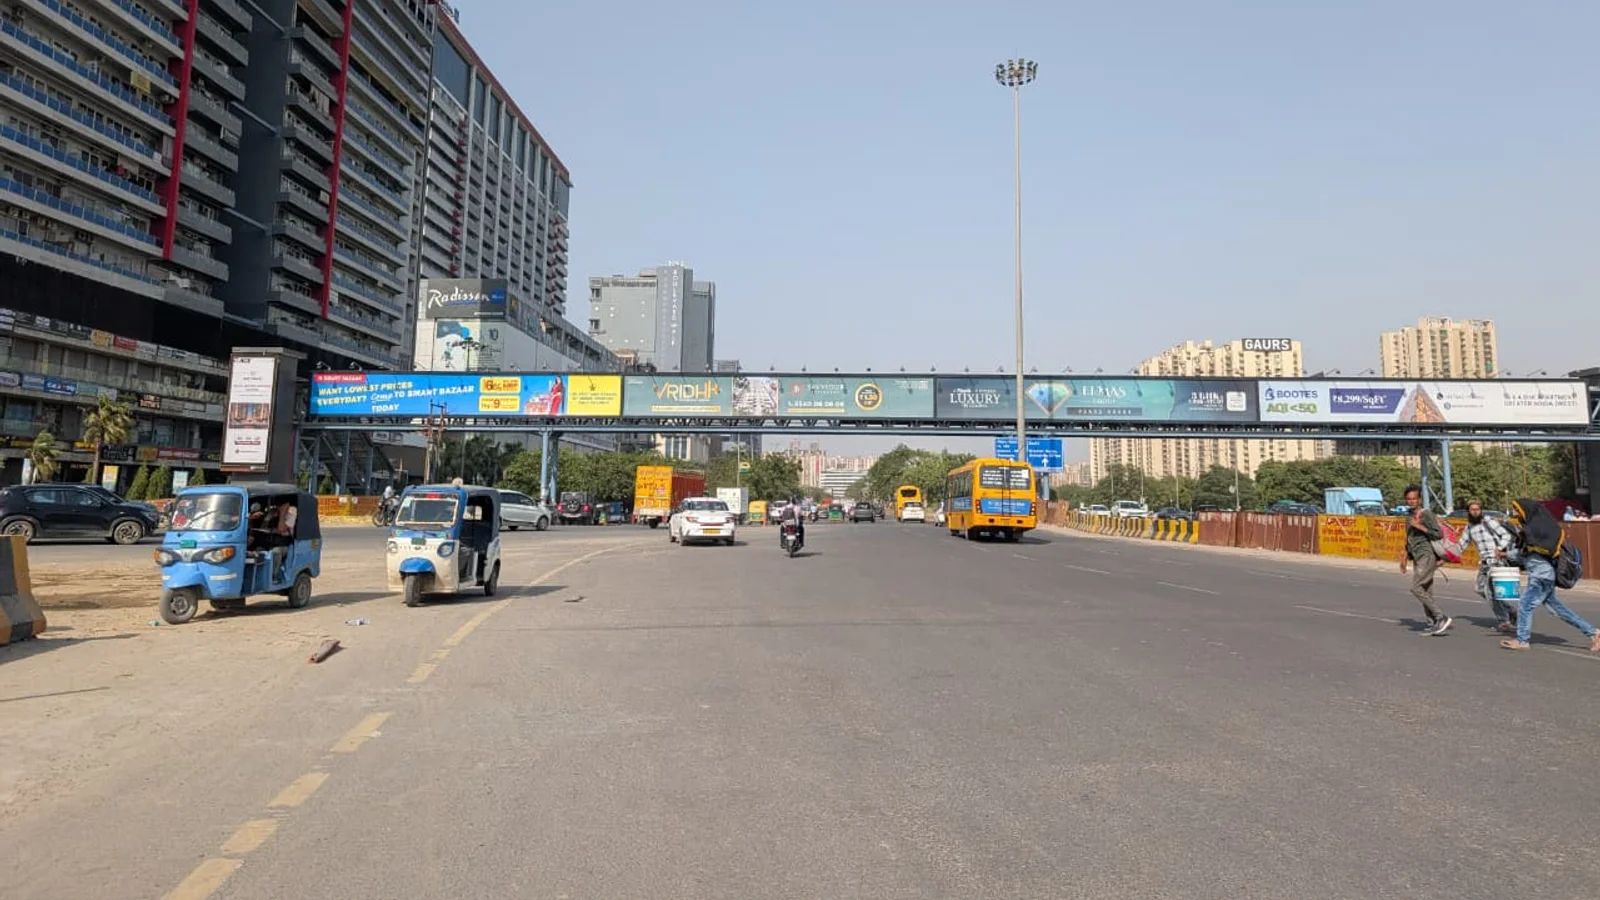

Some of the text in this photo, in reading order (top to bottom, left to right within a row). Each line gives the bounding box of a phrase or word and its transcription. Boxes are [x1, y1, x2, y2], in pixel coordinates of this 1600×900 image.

[1244, 339, 1290, 351] GAURS
[318, 381, 413, 396] WANT LOWEST PRICES
[317, 395, 367, 407] EVERYDAY?
[407, 388, 437, 398] SMART
[439, 385, 475, 395] BAZAAR
[950, 393, 1000, 404] LUXURY
[1276, 390, 1319, 399] BOOTES
[371, 403, 400, 413] TODAY
